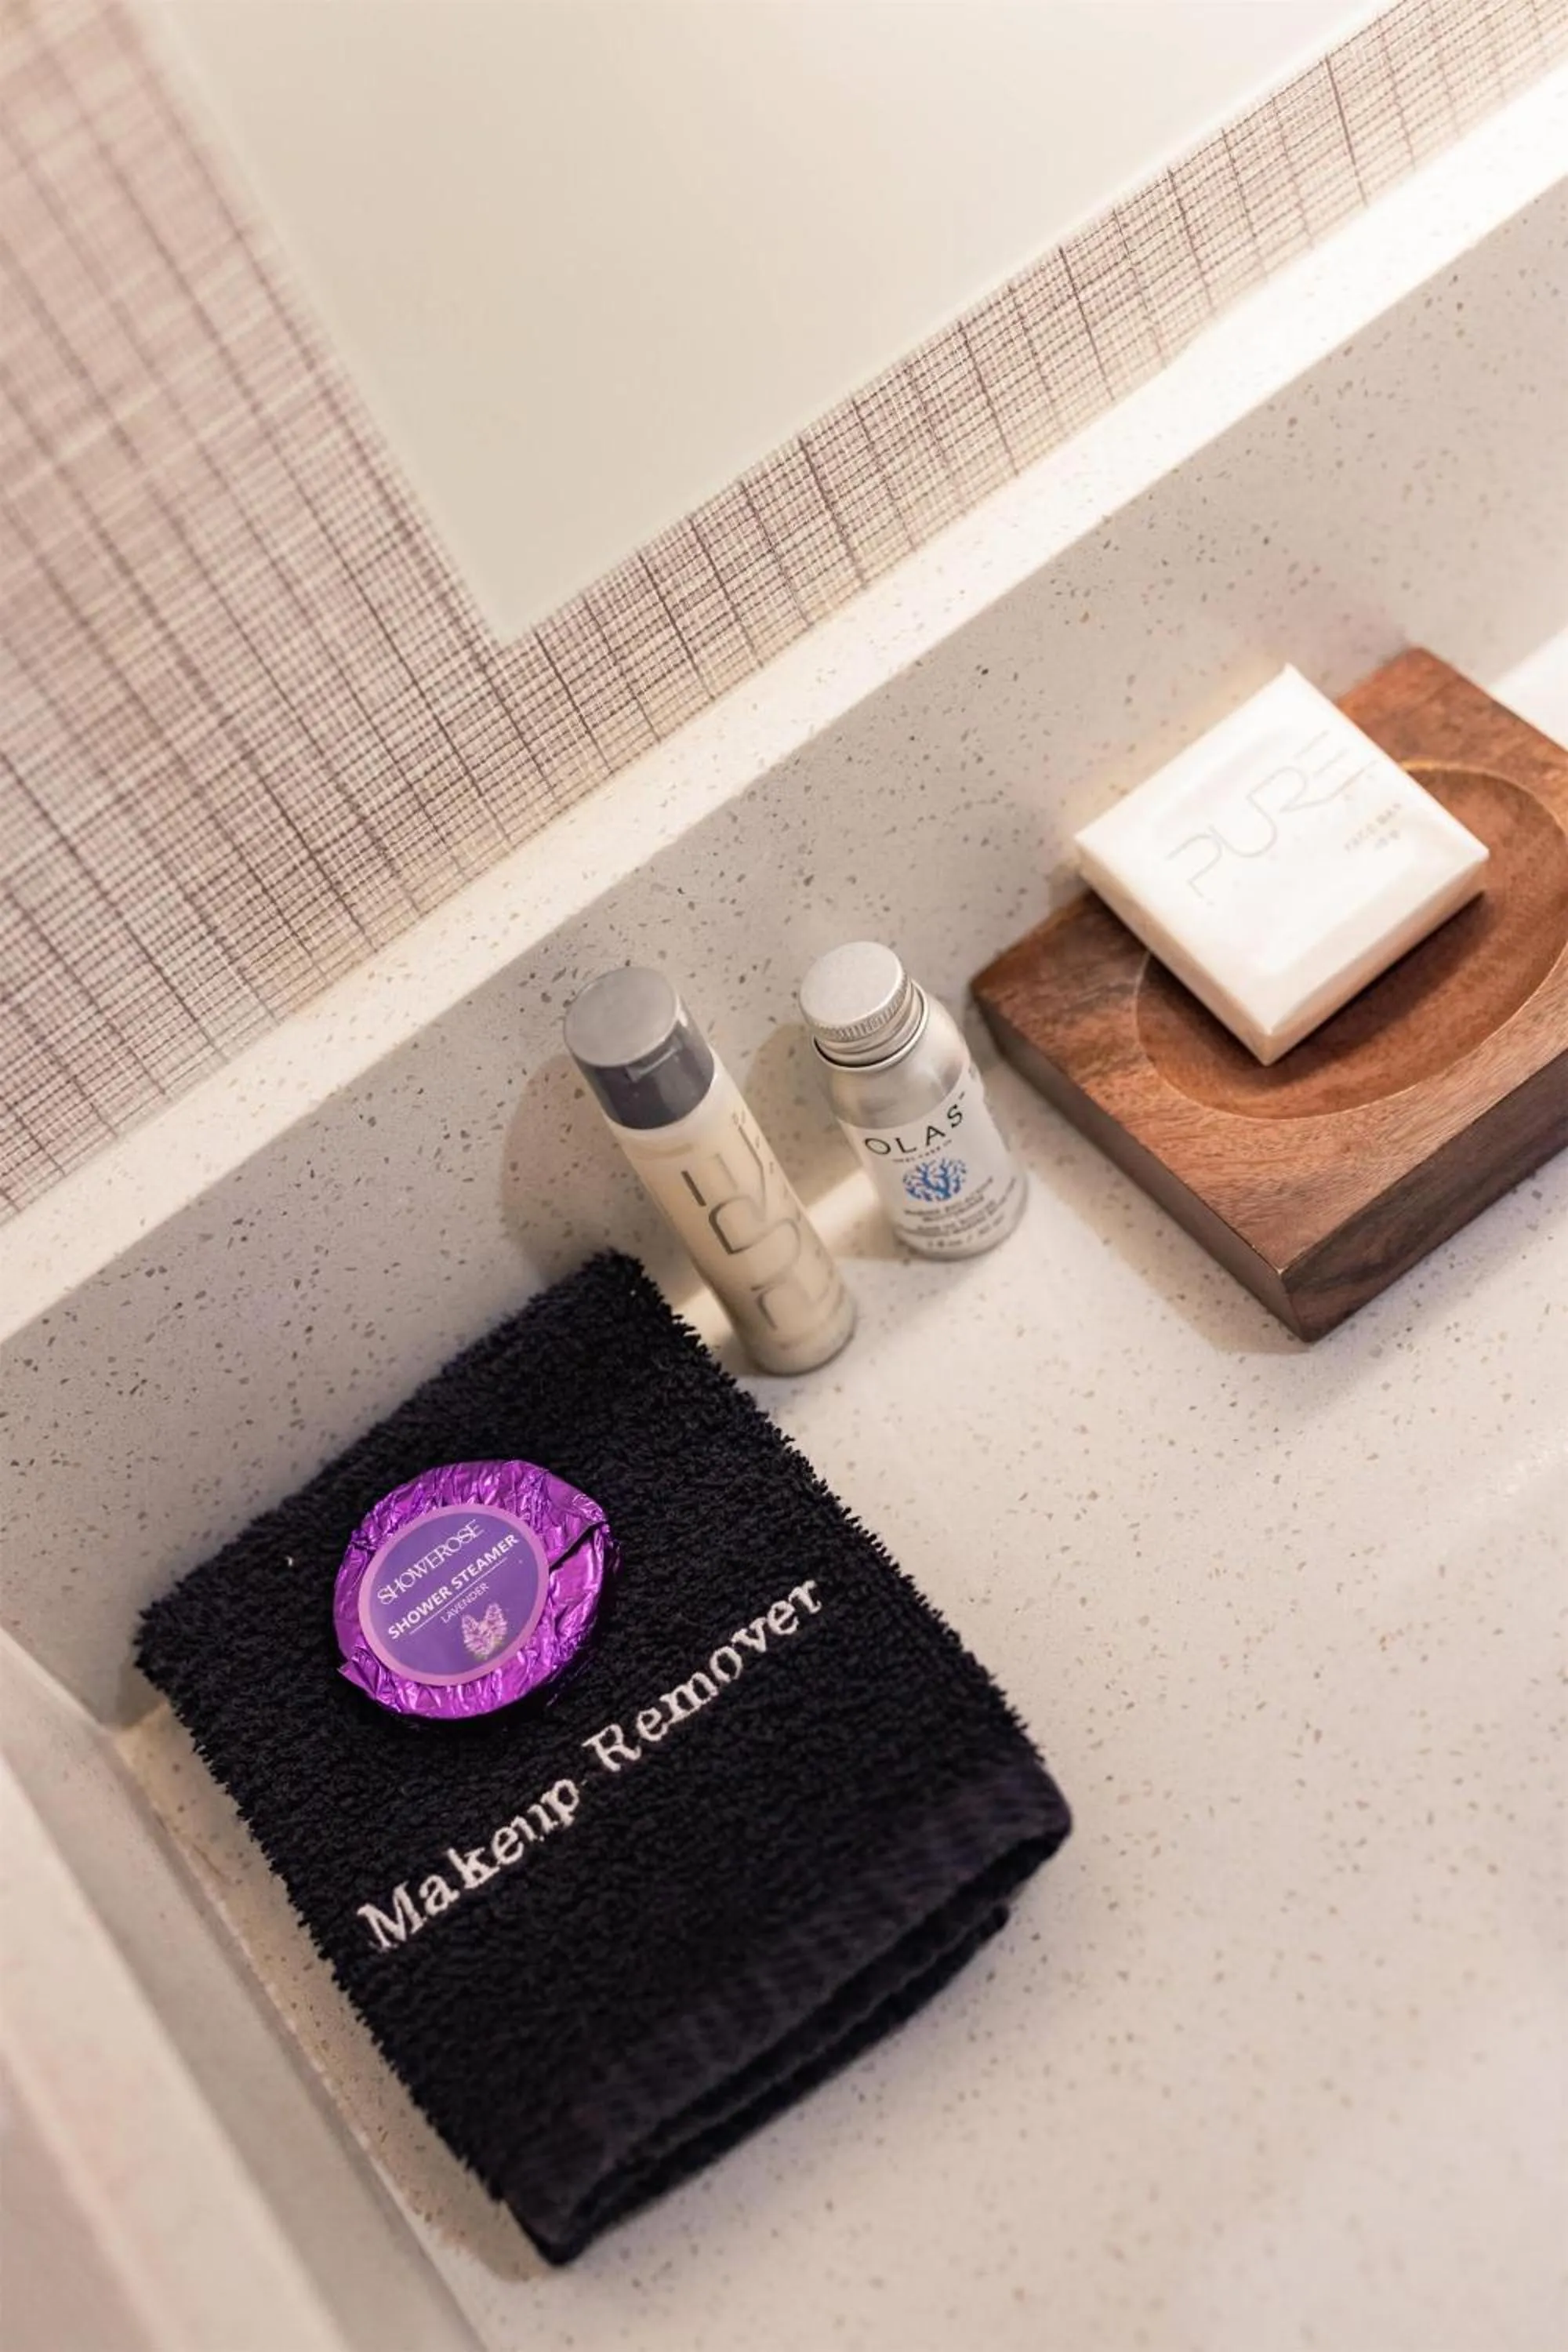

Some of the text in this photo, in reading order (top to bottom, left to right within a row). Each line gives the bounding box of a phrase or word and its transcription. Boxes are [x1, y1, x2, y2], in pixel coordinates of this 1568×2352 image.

[1166, 730, 1378, 898] PURE
[377, 1519, 485, 1605] SHOWEROSE
[388, 1534, 519, 1639] SHOWER STEAMER
[441, 1582, 489, 1624] LAVENDER
[357, 1579, 822, 1953] Makeup Remover
